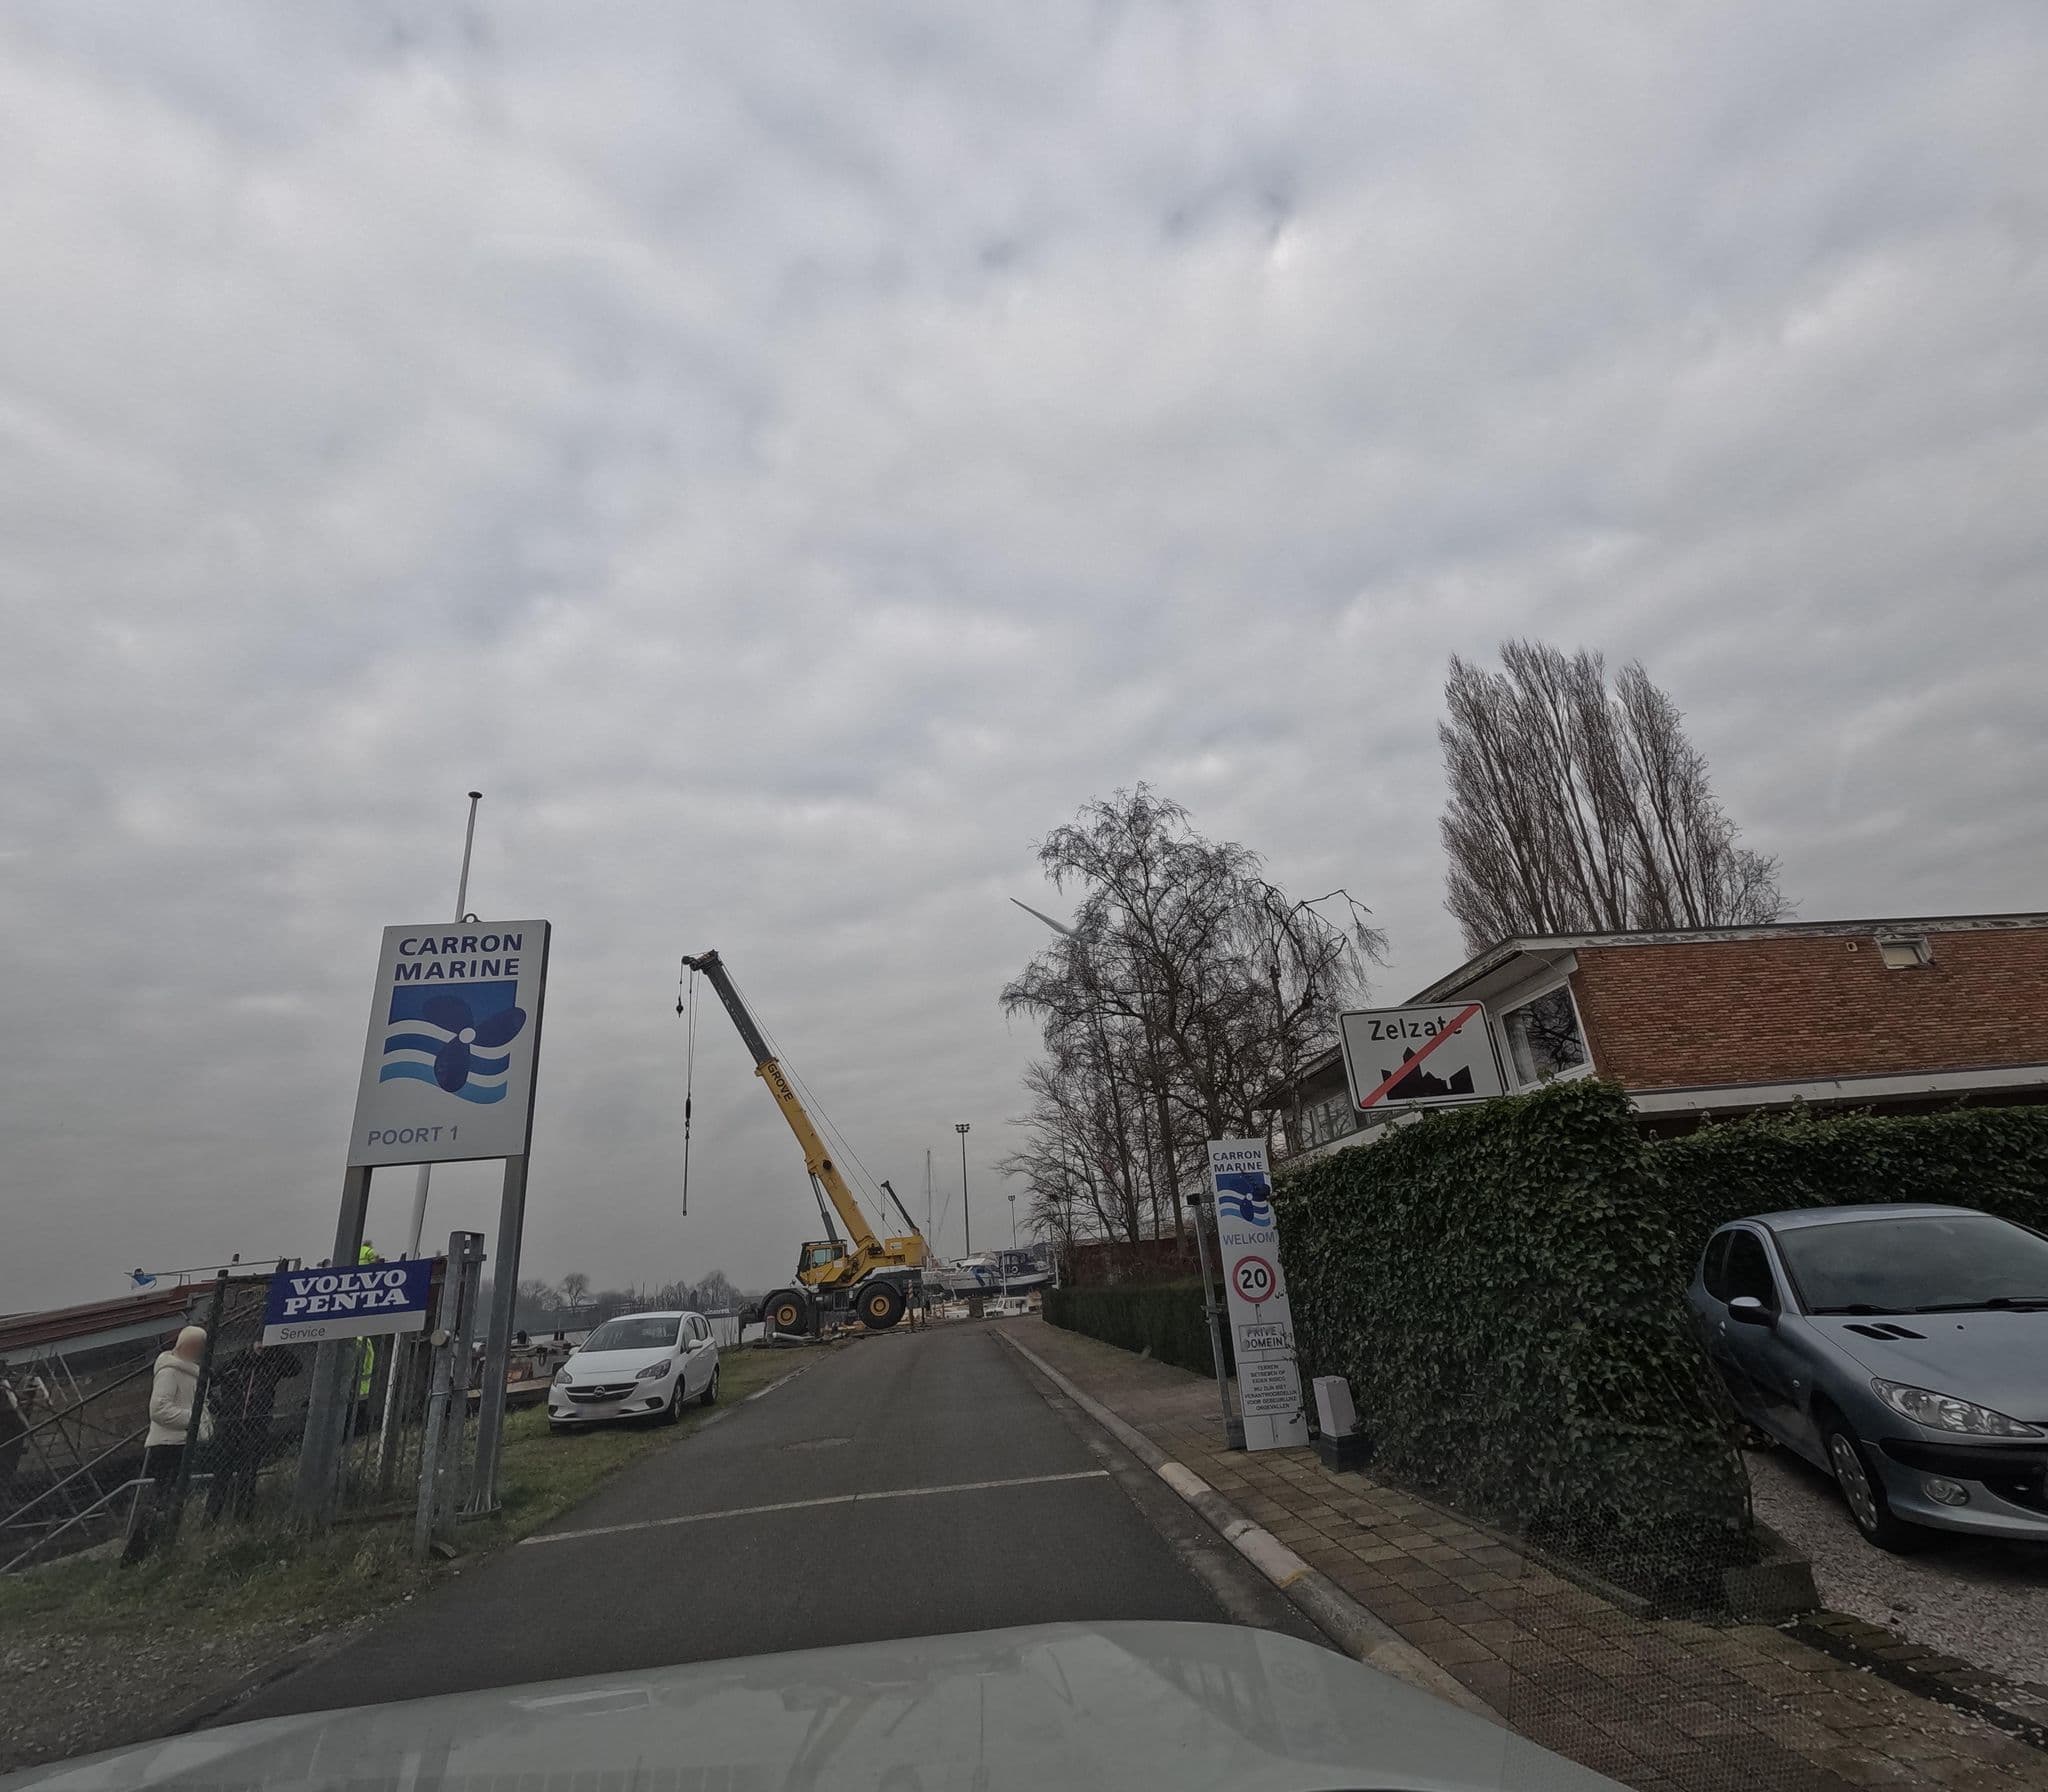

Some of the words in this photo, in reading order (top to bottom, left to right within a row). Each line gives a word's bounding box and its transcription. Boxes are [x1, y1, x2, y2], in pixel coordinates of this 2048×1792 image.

[399, 933, 523, 956] CARRON
[394, 958, 520, 981] MARINE
[767, 1063, 794, 1102] GROVE
[367, 1126, 443, 1146] POORT
[450, 1125, 459, 1141] 1
[1213, 1150, 1262, 1161] CARRON
[1214, 1161, 1263, 1173] MARINE
[1223, 1231, 1275, 1245] WELKOM
[289, 1269, 407, 1296] VOLVO
[1240, 1268, 1268, 1289] 20
[282, 1288, 410, 1316] PENTA
[280, 1326, 326, 1340] Service
